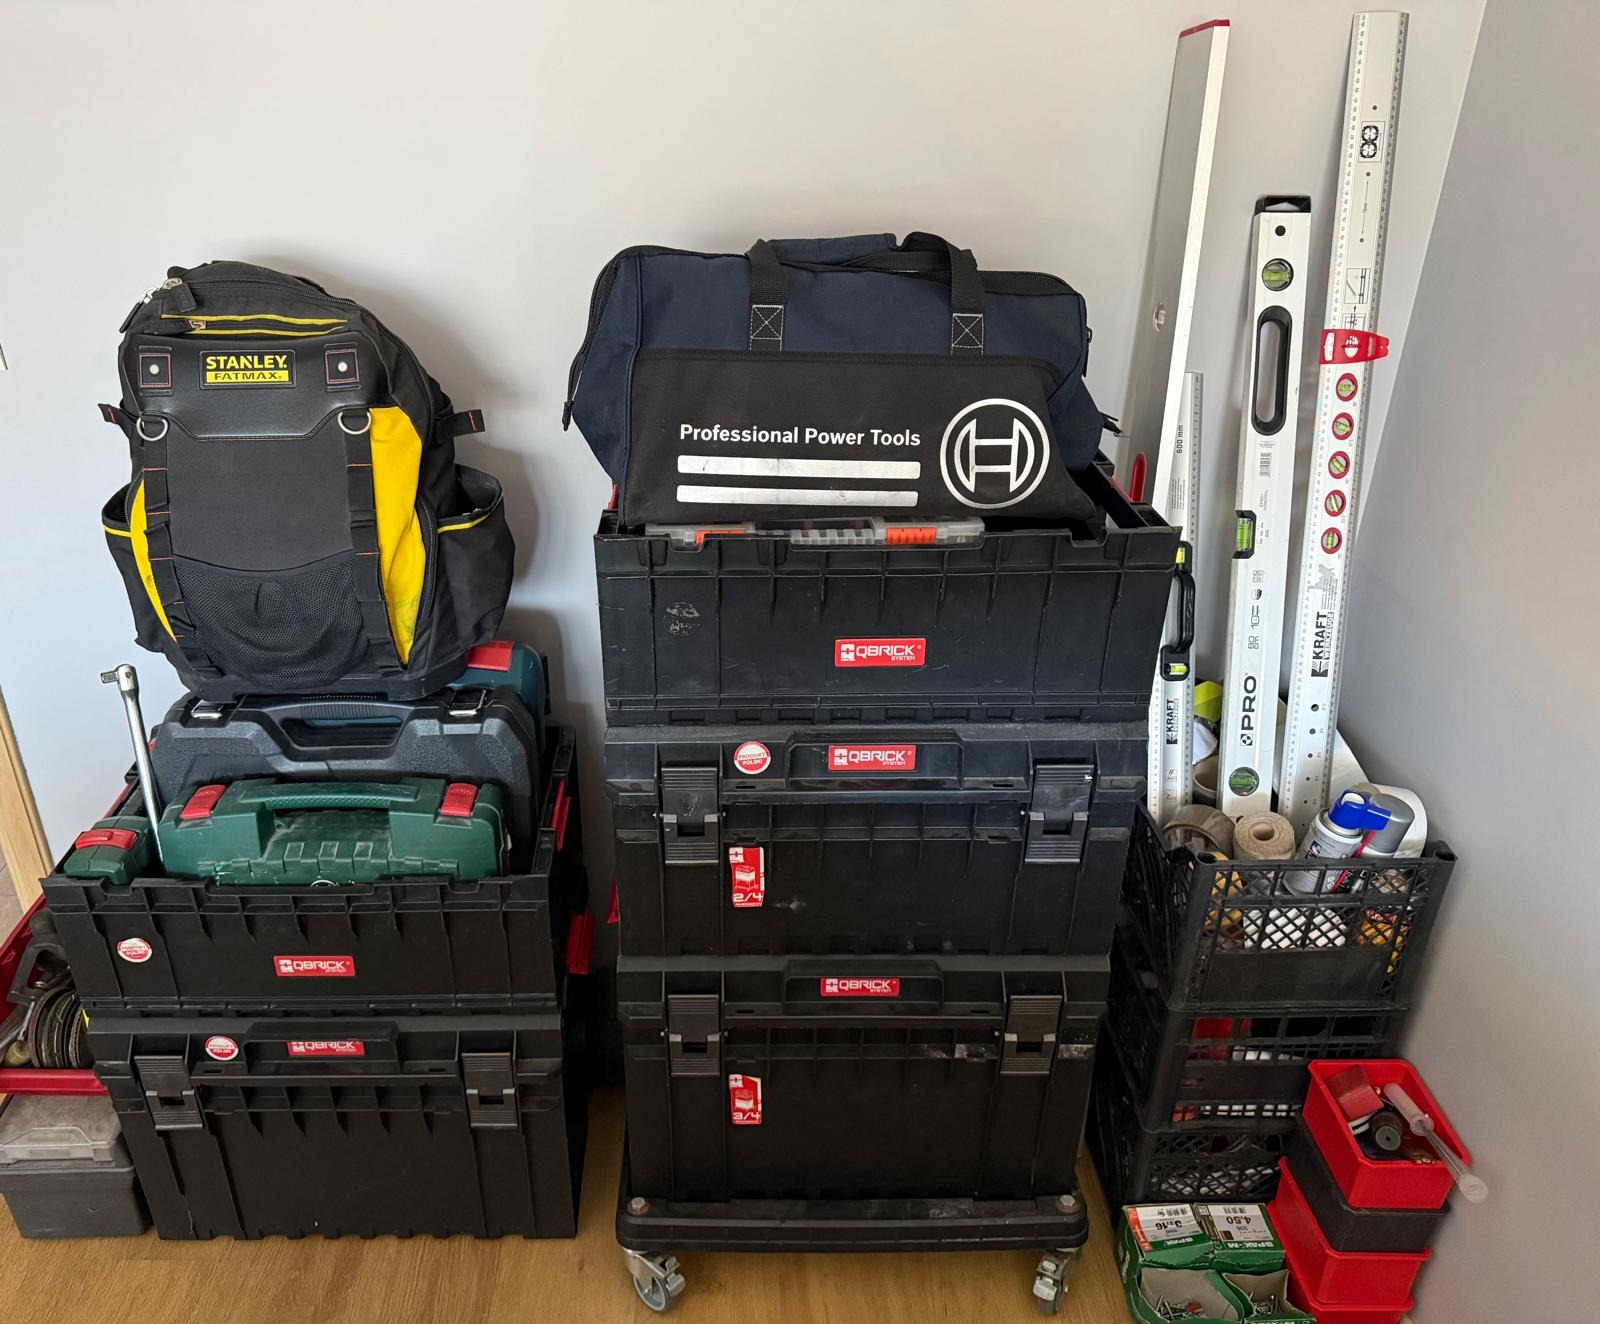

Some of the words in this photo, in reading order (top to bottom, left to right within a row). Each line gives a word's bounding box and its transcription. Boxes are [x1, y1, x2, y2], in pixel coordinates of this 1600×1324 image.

[679, 424, 799, 443] Professional
[804, 427, 865, 445] Power
[870, 429, 921, 446] Tools
[1177, 424, 1184, 438] mm
[1312, 611, 1328, 660] KRAFT
[855, 645, 916, 659] QBRICK
[1241, 675, 1257, 730] PRO
[1166, 698, 1174, 732] KRAFT
[849, 750, 907, 764] QBRICK
[733, 892, 763, 902] 2/4
[292, 960, 347, 971] QBRICK
[839, 979, 892, 991] QBRICK
[305, 1041, 356, 1051] QBRICK
[733, 1111, 761, 1121] 3/4
